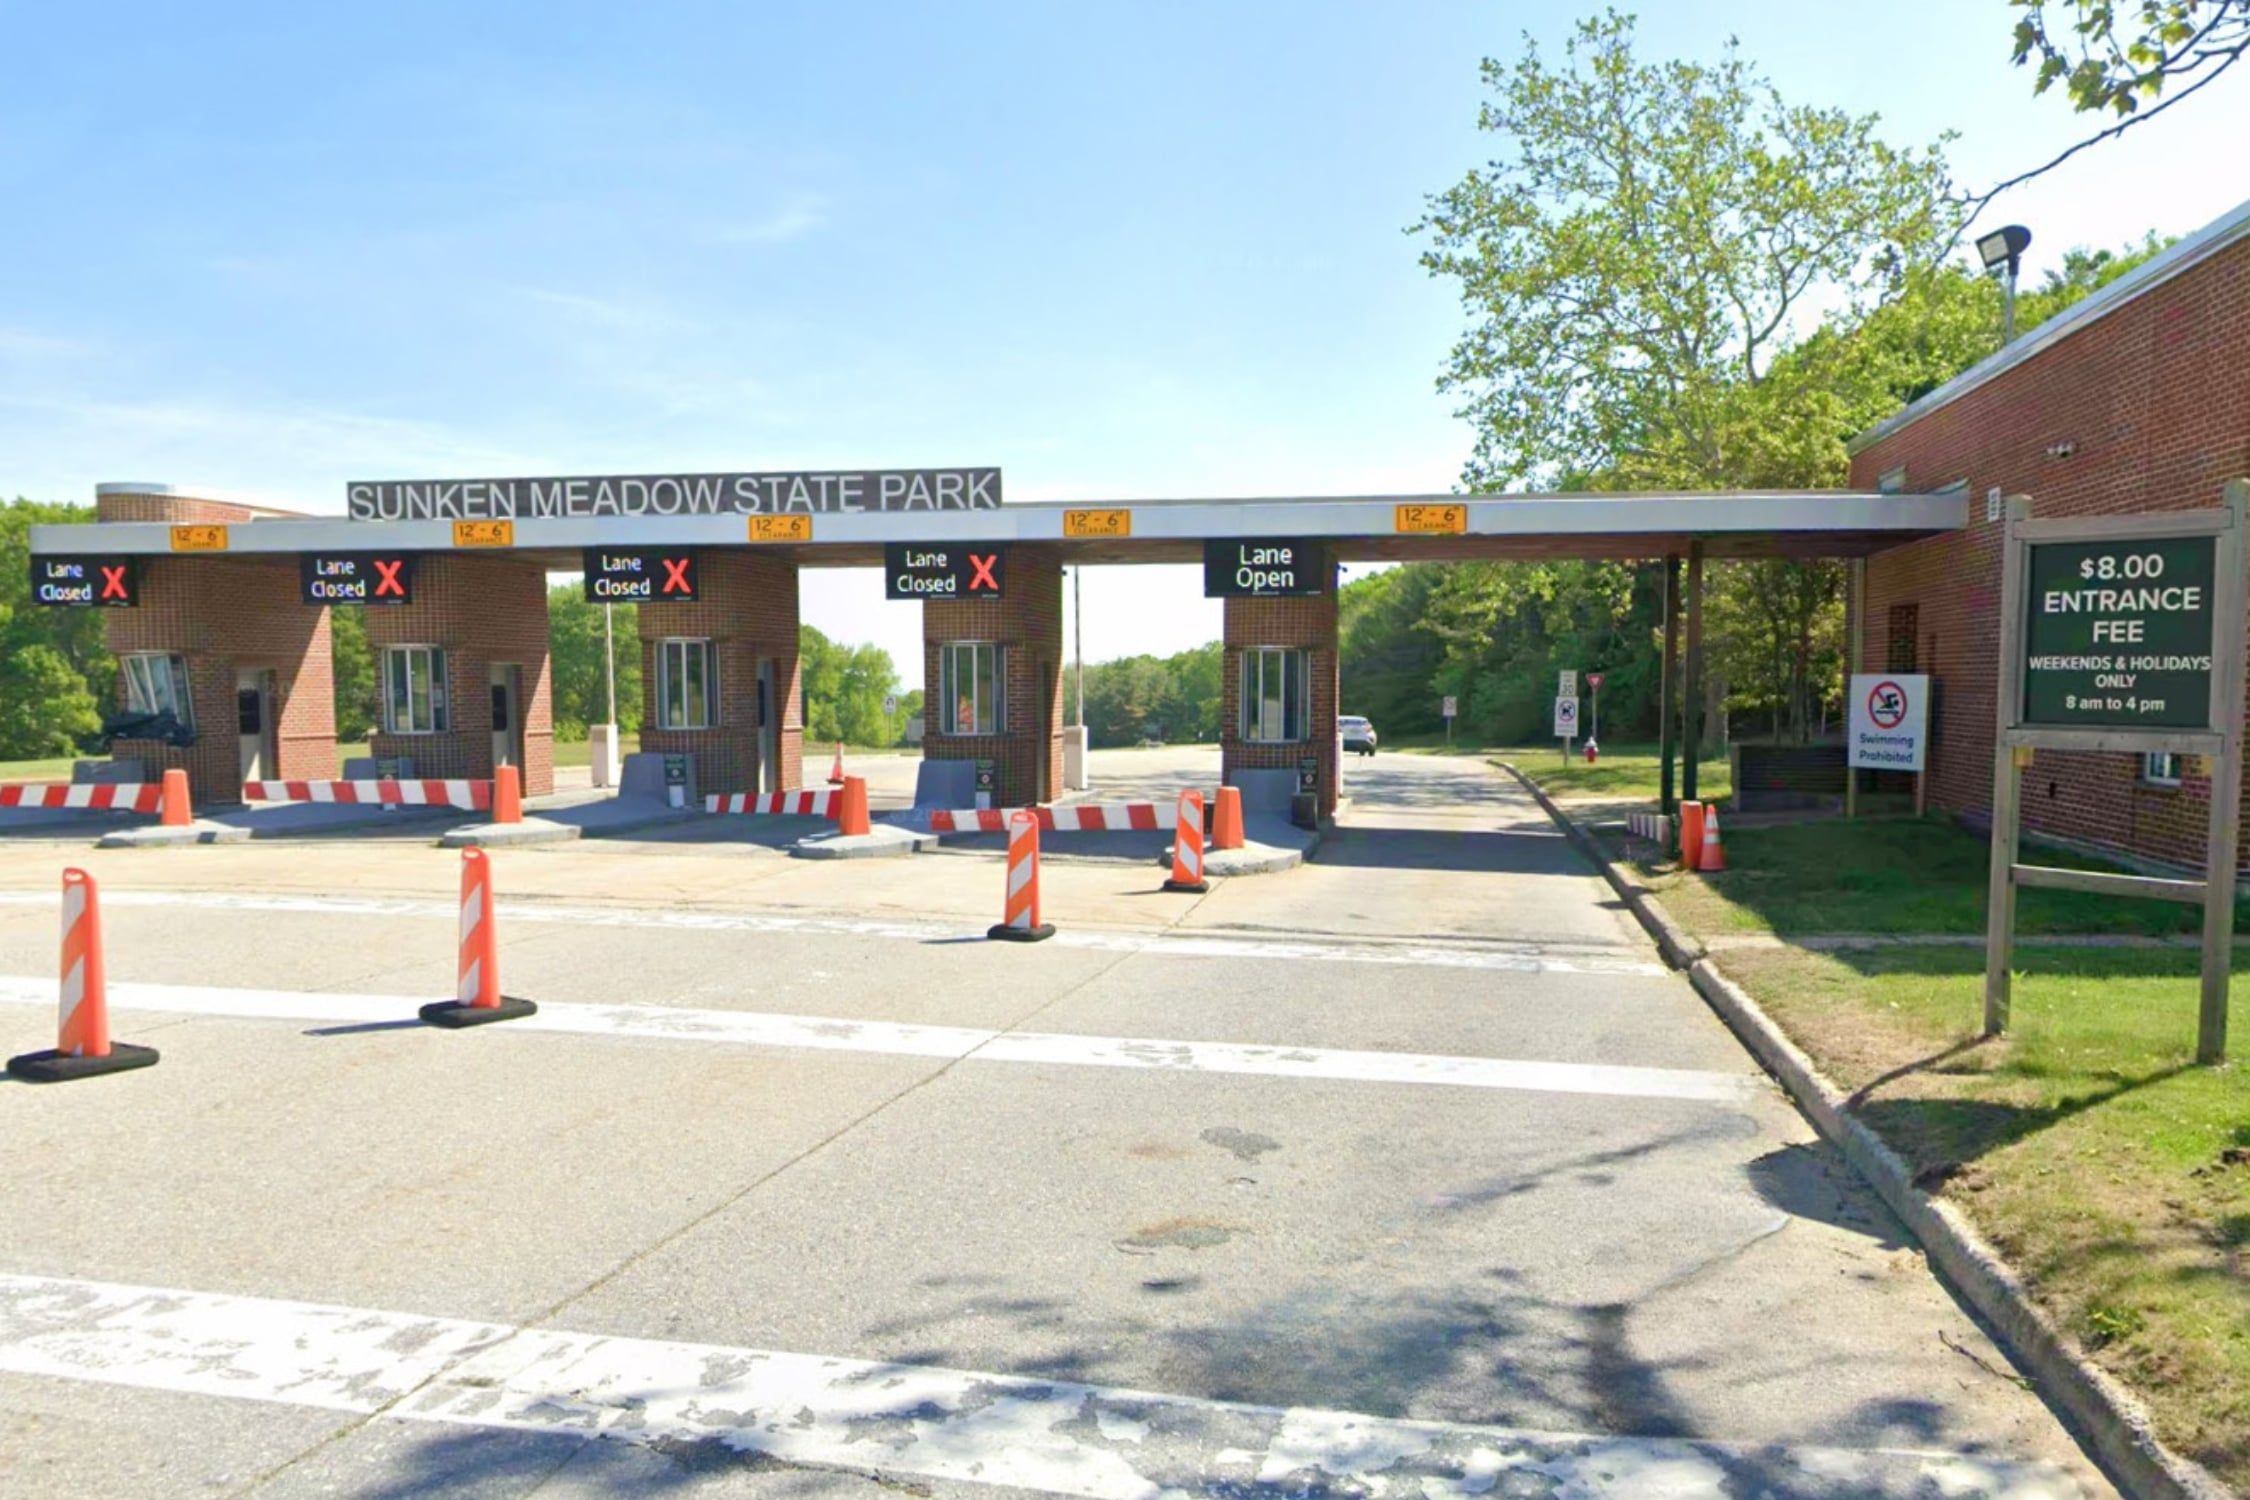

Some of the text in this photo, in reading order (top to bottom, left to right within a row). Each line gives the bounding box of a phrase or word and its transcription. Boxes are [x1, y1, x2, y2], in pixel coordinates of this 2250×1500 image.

[350, 472, 997, 521] SUNKEN MEADOW STATE PARK
[602, 554, 642, 572] Lane
[906, 550, 947, 567] Lane
[1239, 544, 1293, 566] Lane
[46, 561, 83, 579] Lane
[316, 559, 356, 575] Lane
[2080, 554, 2164, 580] $8.00
[594, 578, 650, 596] Closed
[897, 574, 956, 592] Closed
[1236, 567, 1294, 590] Open
[39, 583, 92, 601] Closed
[311, 579, 366, 597] Closed
[2044, 587, 2201, 613] ENTRANCE
[2093, 620, 2145, 643] FEE
[2029, 656, 2211, 671] WEEKENDS & HOLIDAYS
[2095, 674, 2137, 688] ONLY
[2065, 695, 2165, 714] 8 am to 4 pm
[1860, 733, 1914, 748] Swimming
[1859, 750, 1914, 763] Prohibited
